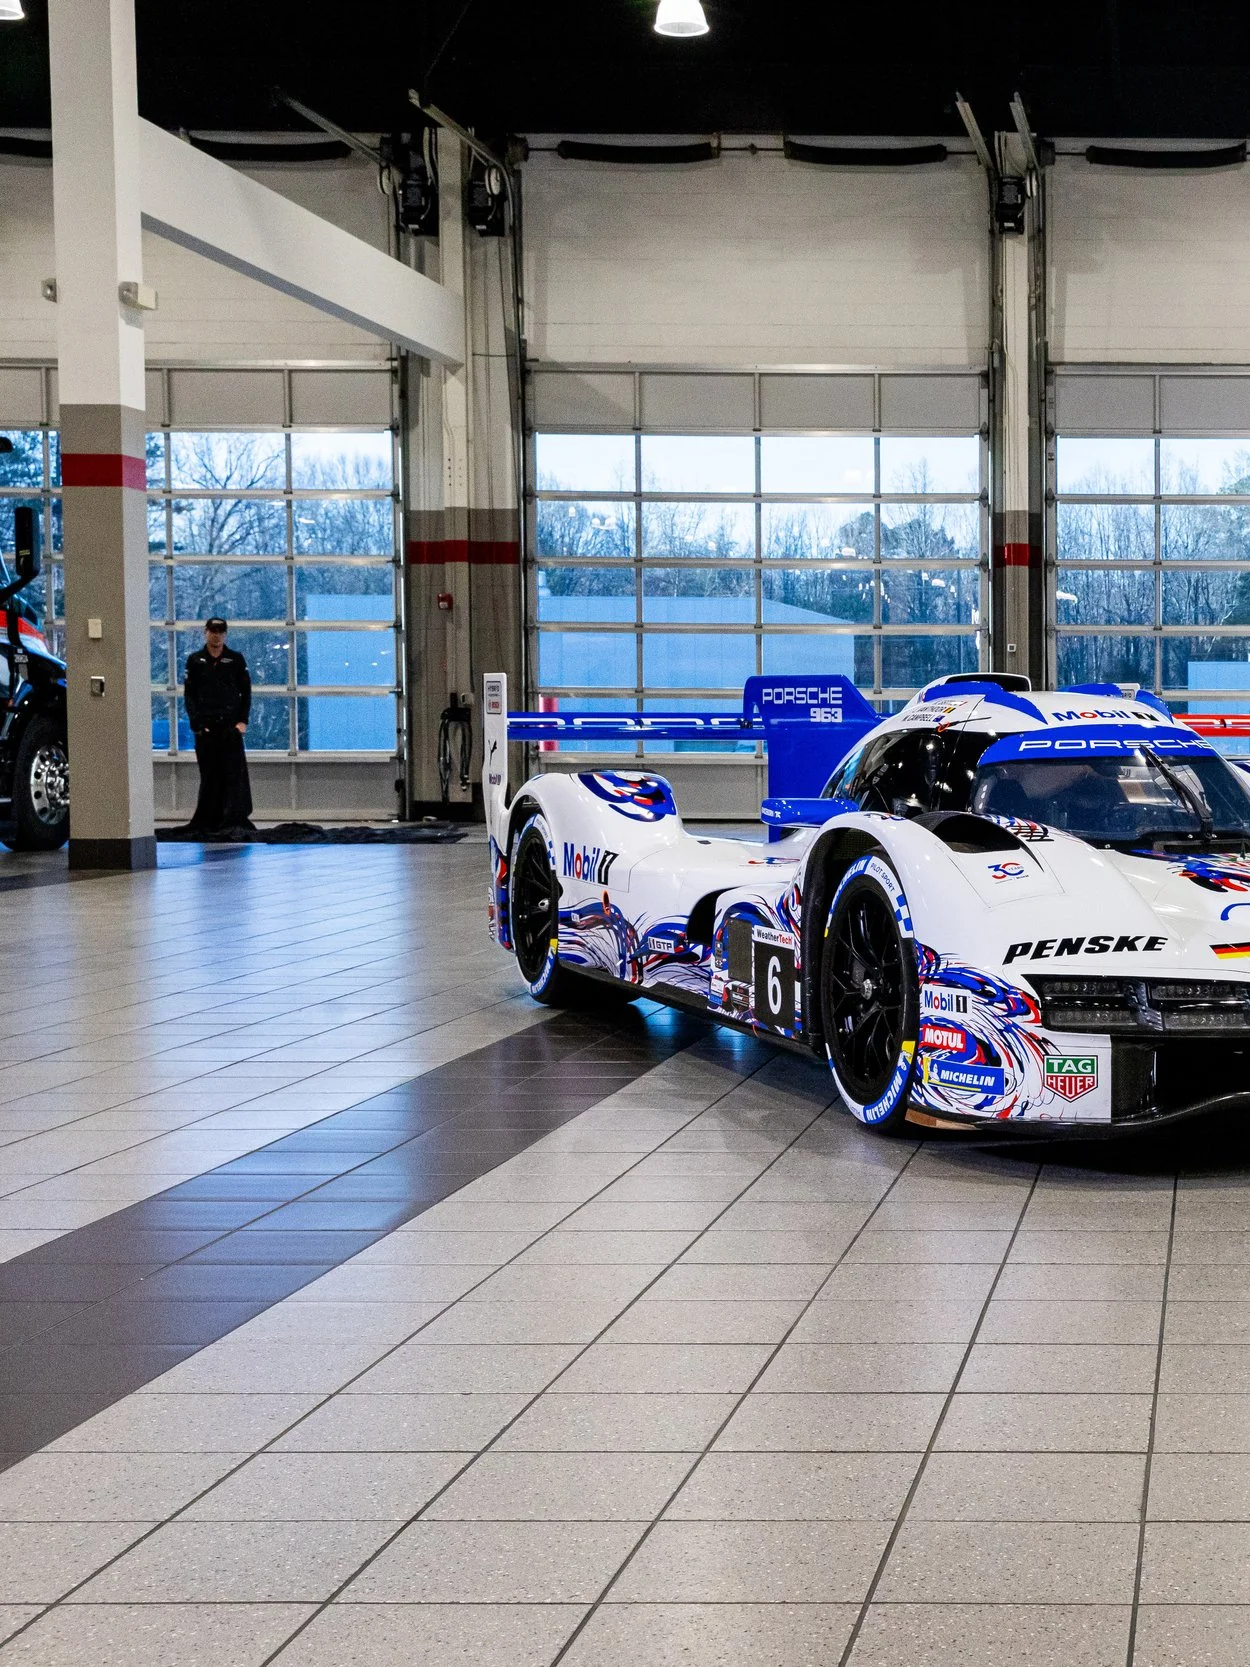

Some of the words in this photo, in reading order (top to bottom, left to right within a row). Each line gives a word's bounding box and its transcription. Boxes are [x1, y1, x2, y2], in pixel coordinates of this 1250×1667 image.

[762, 687, 842, 704] PORSCHE
[810, 708, 842, 722] 963
[1052, 710, 1130, 722] Mobil
[1019, 740, 1214, 752] PORSCHE
[564, 842, 600, 882] Mobil
[598, 850, 619, 886] 1
[870, 862, 883, 874] PILOT
[881, 872, 895, 892] SPORT
[656, 941, 673, 950] GTP
[756, 928, 793, 945] WeatherTech
[1002, 935, 1169, 965] PENSKE
[767, 955, 782, 1015] 6
[924, 990, 953, 1012] Mobil
[956, 994, 968, 1014] 1
[925, 1027, 964, 1049] MOTUL
[1048, 1059, 1092, 1073] TAG
[940, 1069, 996, 1087] MICHELIN
[1046, 1076, 1094, 1097] HEUER
[866, 1070, 903, 1121] MICHELIN
